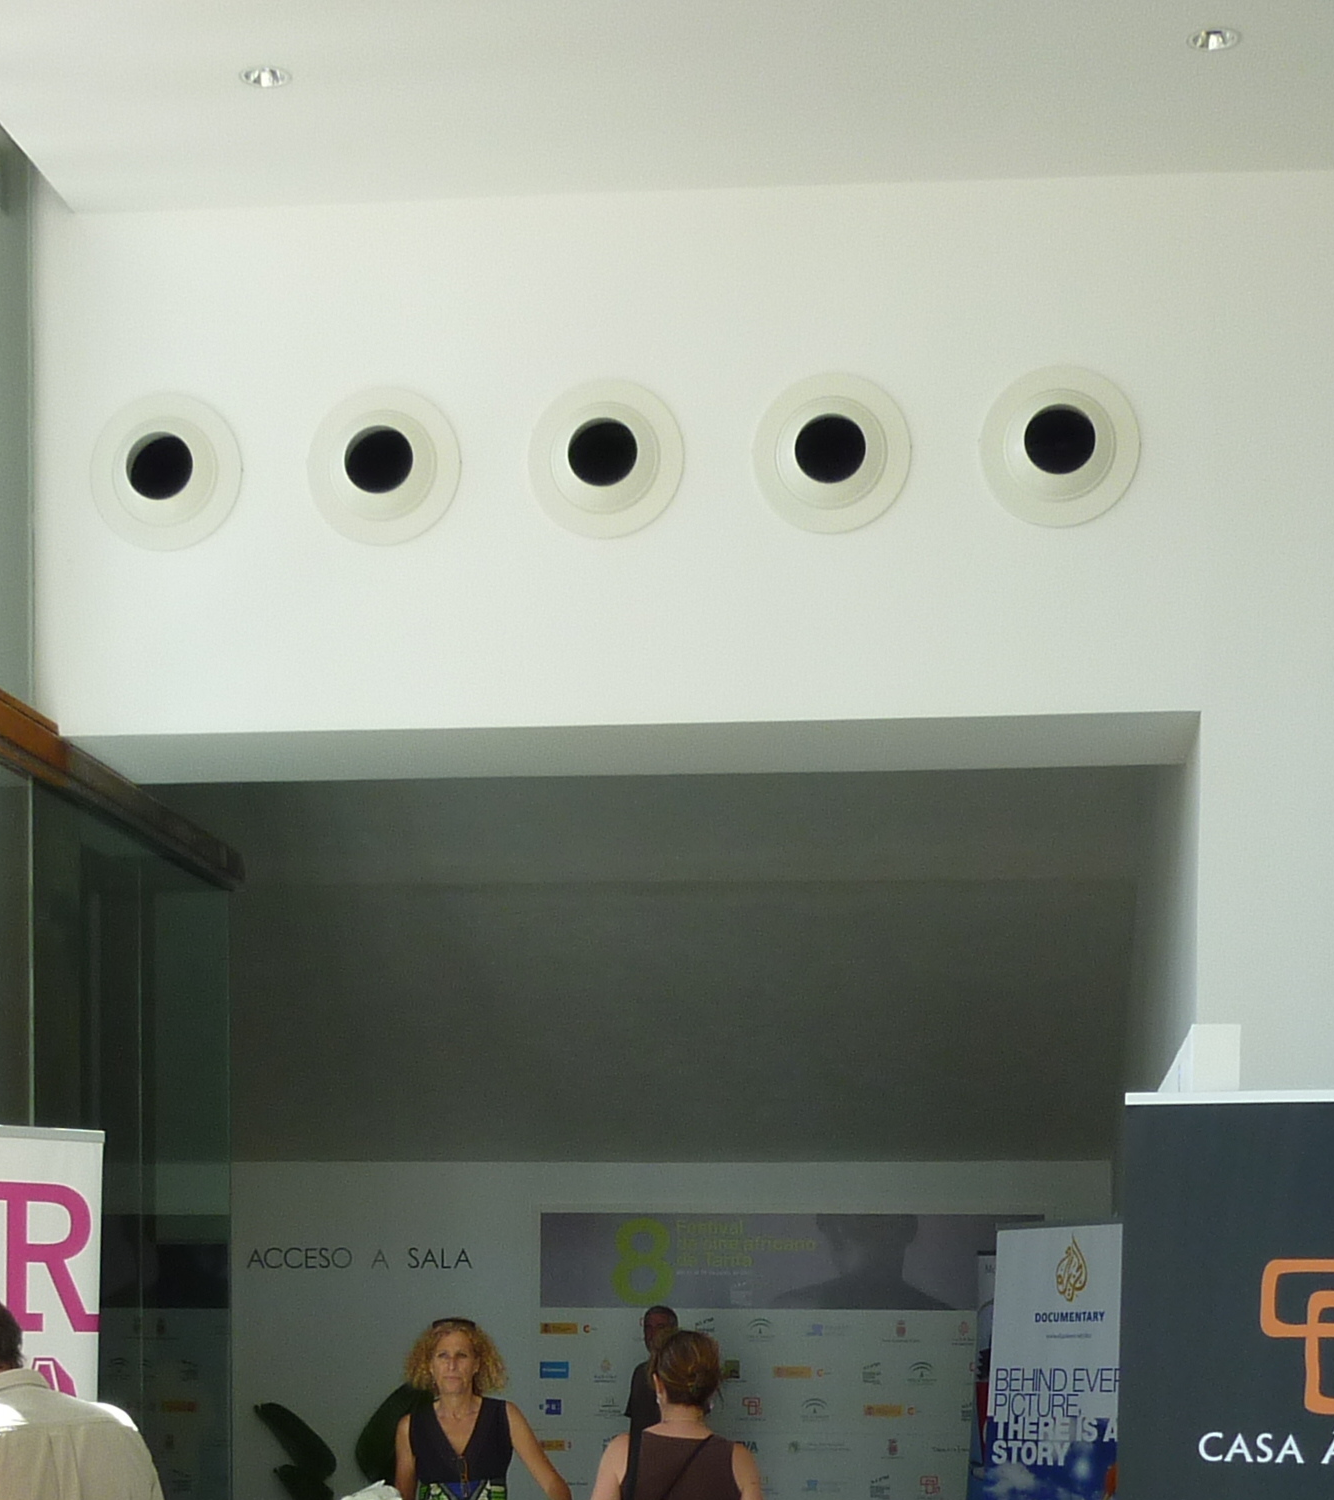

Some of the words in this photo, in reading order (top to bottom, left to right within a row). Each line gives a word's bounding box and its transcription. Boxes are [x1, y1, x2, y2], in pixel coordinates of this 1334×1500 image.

[743, 1236, 817, 1252] africano
[246, 1247, 353, 1270] ACCESO
[371, 1249, 390, 1270] A
[407, 1247, 473, 1270] SALA
[611, 1217, 673, 1306] 8
[676, 1253, 698, 1268] de
[1034, 1311, 1105, 1323] DOCUMENTARY
[995, 1368, 1067, 1392] BEHIND
[993, 1393, 1082, 1418] PICTURE,
[994, 1416, 1071, 1441] THERE
[1076, 1418, 1098, 1442] IS
[991, 1441, 1071, 1466] STORY
[1198, 1432, 1305, 1464] CASA
